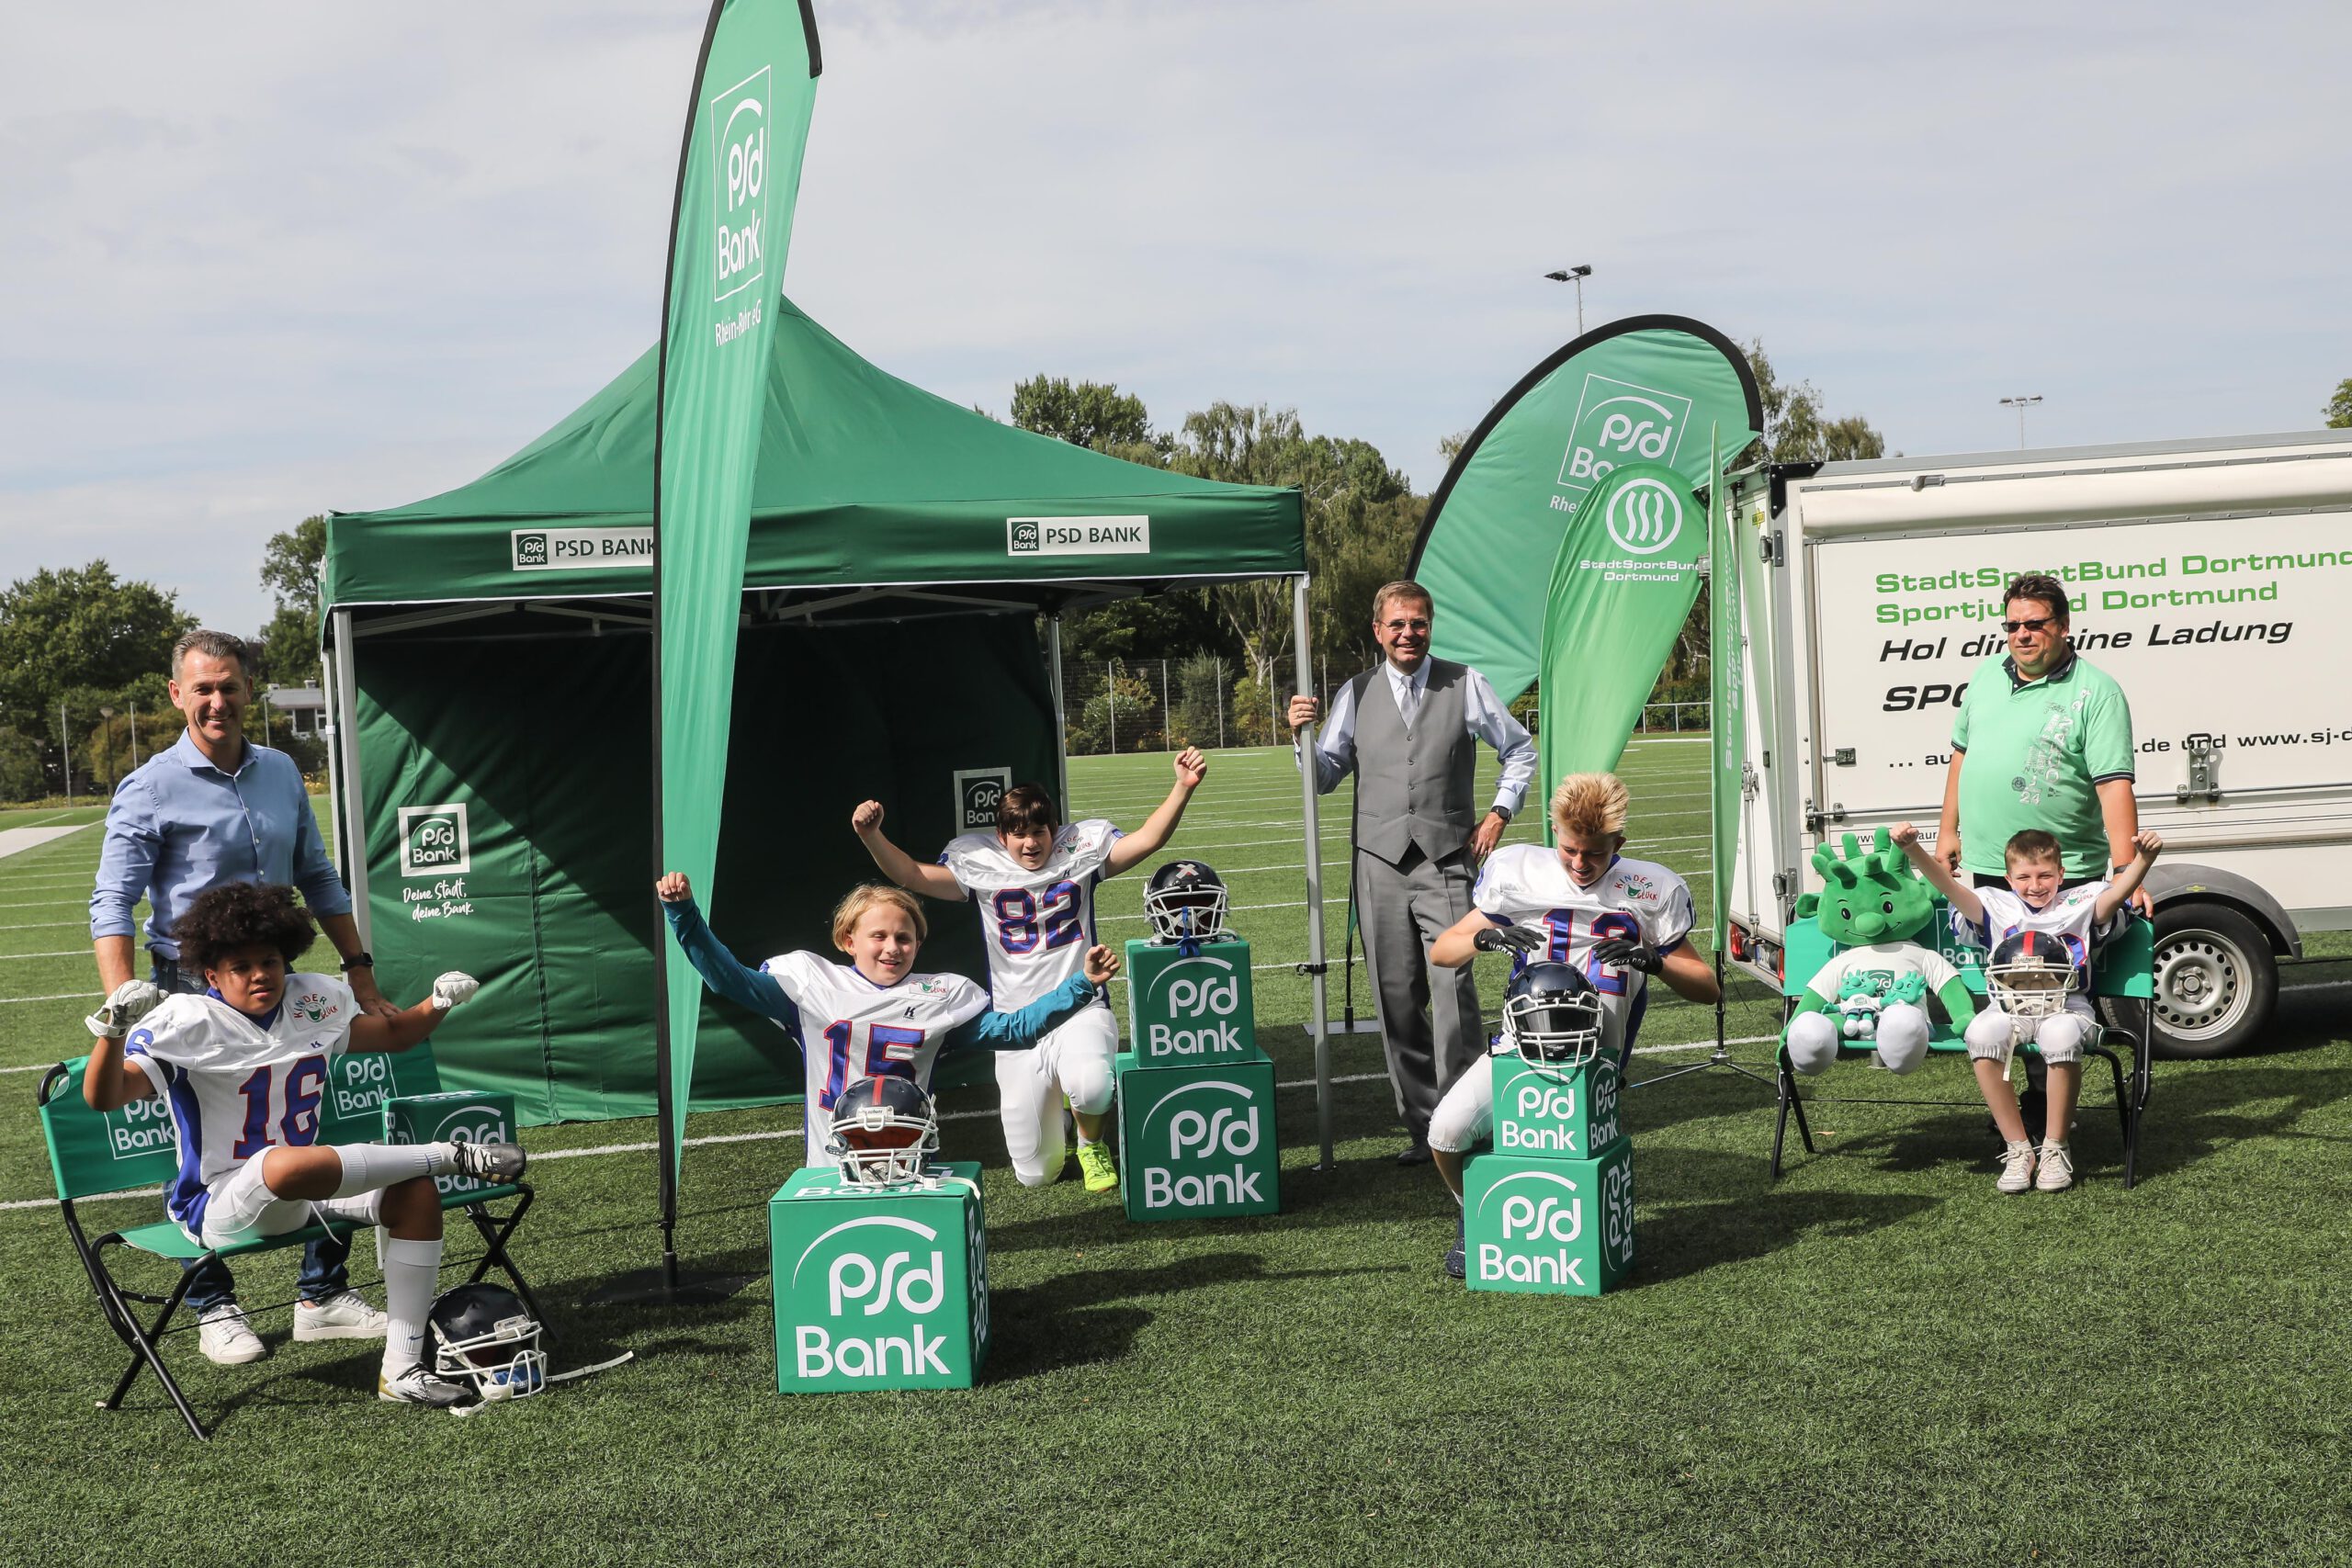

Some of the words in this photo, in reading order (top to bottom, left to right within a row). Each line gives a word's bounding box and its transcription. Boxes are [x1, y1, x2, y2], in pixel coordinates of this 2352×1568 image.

[728, 127, 763, 212] psd
[718, 209, 761, 280] Bank
[1599, 413, 1673, 458] psd
[525, 541, 545, 554] psd
[556, 540, 594, 557] PSD
[1013, 540, 1037, 549] Bank
[1019, 529, 1037, 540] psd
[1046, 528, 1082, 544] PSD
[1089, 527, 1142, 542] BANK
[519, 553, 545, 563] Bank
[1604, 571, 1679, 581] Dortmund
[1876, 592, 2087, 626] Sportjud
[2102, 581, 2278, 610] Dortmund
[1880, 637, 1948, 662] Hol
[1961, 634, 2008, 658] dir
[2147, 620, 2294, 647] Ladung
[967, 809, 999, 824] Ban
[2020, 792, 2041, 805] 24
[413, 847, 457, 863] Bank
[422, 827, 455, 847] psd
[402, 887, 433, 903] Deine
[434, 877, 468, 900] Stadt,
[1614, 874, 1654, 889] KINDER
[412, 904, 441, 922] deine
[441, 901, 474, 919] Bank.
[992, 880, 1085, 954] 82
[1542, 908, 1641, 997] 12
[294, 993, 327, 1019] KINDER
[1169, 979, 1238, 1018] psd
[1149, 1021, 1243, 1056] Bank
[345, 1055, 386, 1086] psd
[819, 1020, 925, 1112] 15
[233, 1054, 327, 1159] 16
[337, 1084, 390, 1111] Bank
[1518, 1086, 1575, 1120] psd
[1595, 1076, 1616, 1117] psd
[114, 1122, 175, 1151] Bank
[1170, 1106, 1260, 1159] psd
[1501, 1120, 1577, 1151] Bank
[1590, 1113, 1618, 1151] Bank
[1145, 1163, 1265, 1208] Bank
[1502, 1195, 1582, 1242] psd
[1608, 1165, 1622, 1247] psd
[1621, 1153, 1634, 1264] Bank
[1478, 1243, 1586, 1286] Bank
[829, 1250, 944, 1316] psd
[968, 1205, 980, 1362] Bank
[796, 1324, 952, 1378] Bank
